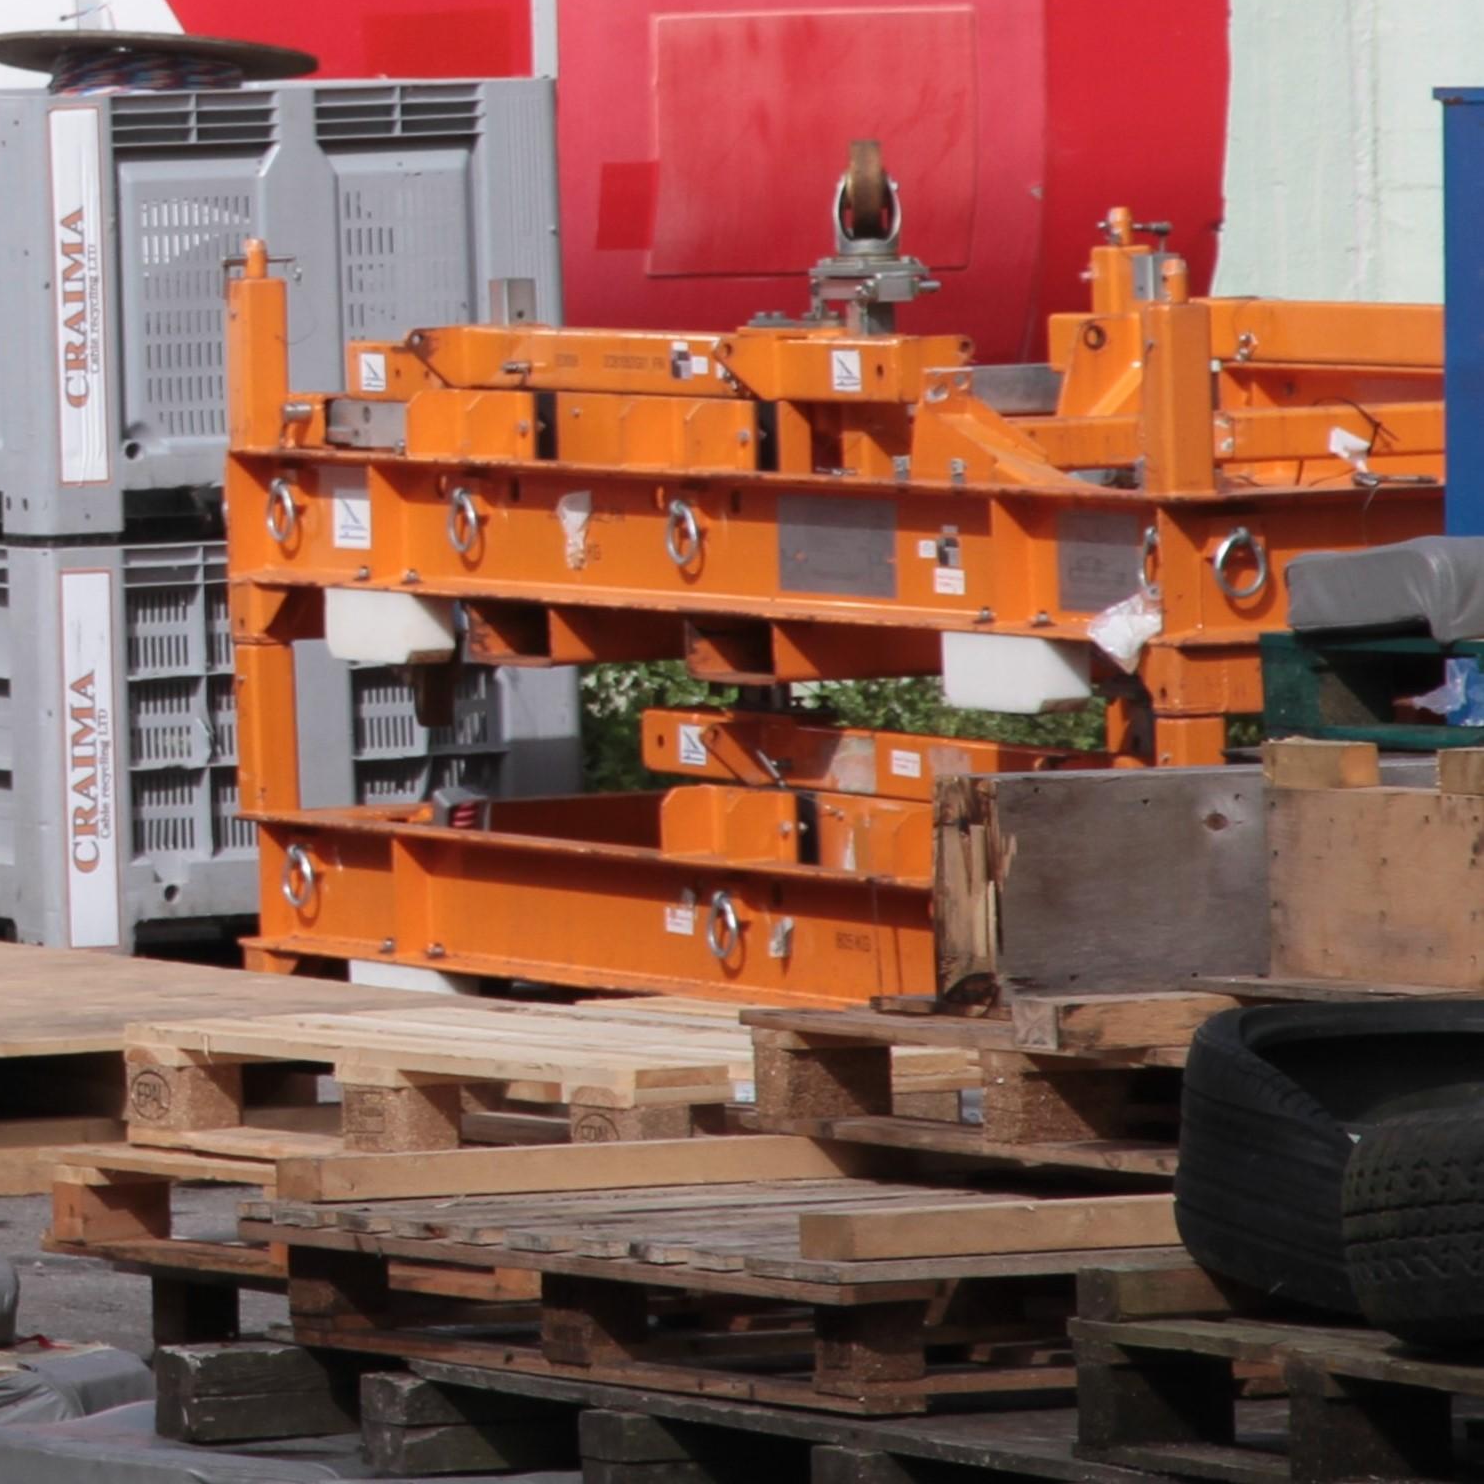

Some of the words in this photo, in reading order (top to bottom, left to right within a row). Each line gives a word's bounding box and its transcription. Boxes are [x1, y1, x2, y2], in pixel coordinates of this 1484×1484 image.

[87, 244, 97, 271] LTD
[60, 206, 90, 409] CRAIMA
[88, 274, 100, 333] recycling
[89, 336, 101, 374] Cable
[97, 708, 108, 736] LTD
[69, 669, 100, 874] CRAIMA
[98, 740, 111, 799] recycling
[99, 802, 111, 839] Cable
